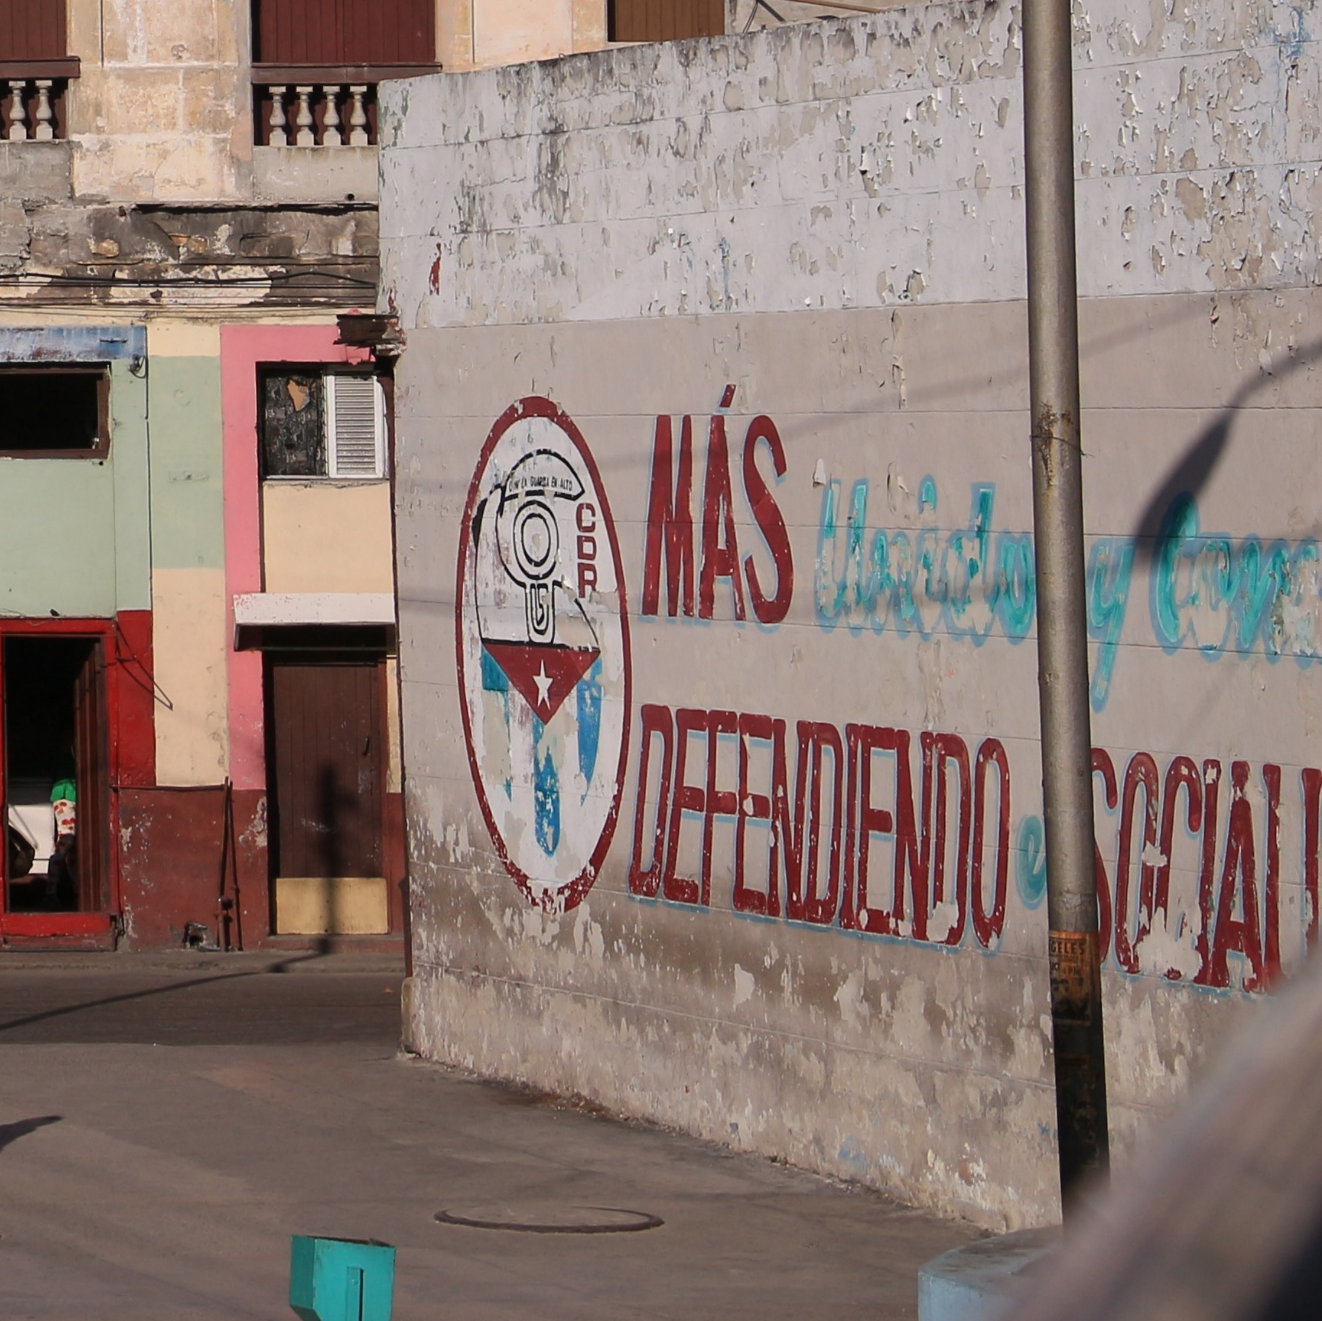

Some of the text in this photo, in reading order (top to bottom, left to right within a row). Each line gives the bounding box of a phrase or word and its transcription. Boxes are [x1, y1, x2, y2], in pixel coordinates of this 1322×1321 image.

[641, 384, 794, 624] MÁS
[815, 474, 1037, 646] Unido
[1086, 536, 1137, 713] y
[627, 704, 1010, 953] DEFENDIENDO
[1049, 938, 1085, 955] GELES
